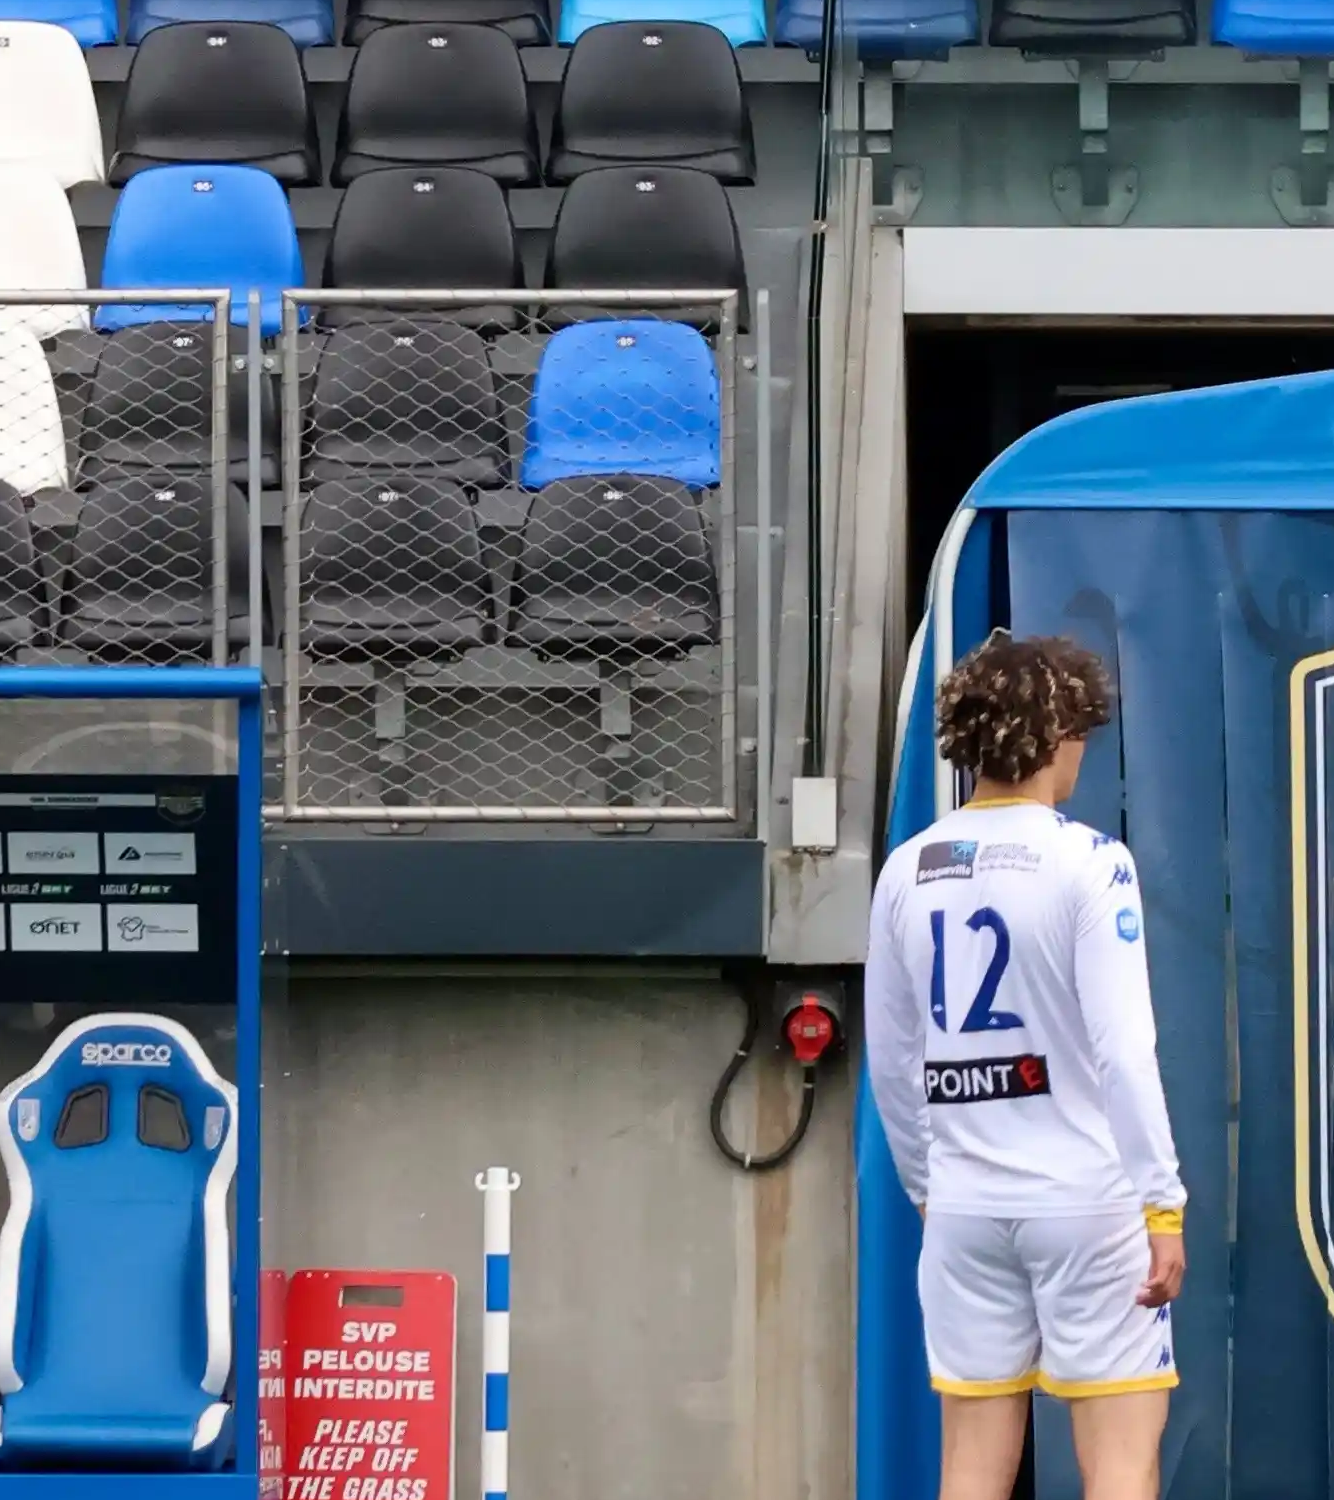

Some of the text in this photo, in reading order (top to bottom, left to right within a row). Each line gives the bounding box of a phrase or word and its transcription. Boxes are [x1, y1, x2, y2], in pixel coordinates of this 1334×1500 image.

[928, 905, 1027, 1034] 12
[81, 1042, 172, 1067] sparco
[925, 1064, 1014, 1098] POINT
[342, 1320, 397, 1343] SVP
[303, 1349, 431, 1372] PELOUSE
[294, 1377, 435, 1401] INTERDITE
[313, 1418, 408, 1446] PLEASE
[299, 1446, 365, 1473] KEEP
[371, 1447, 419, 1474] OFF
[287, 1475, 335, 1500] THE
